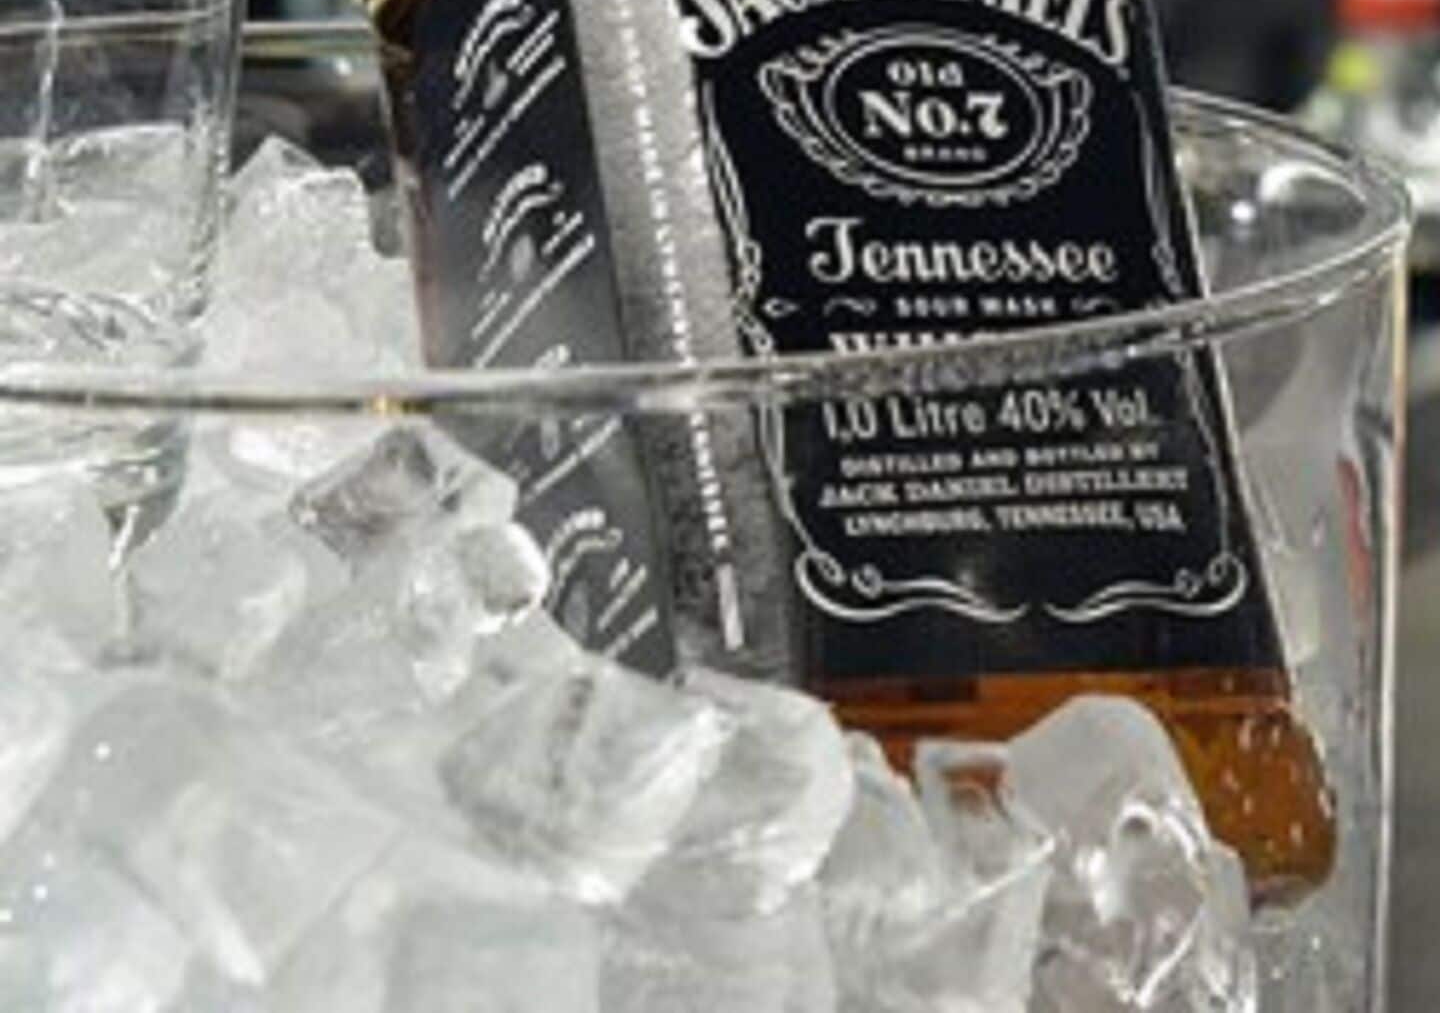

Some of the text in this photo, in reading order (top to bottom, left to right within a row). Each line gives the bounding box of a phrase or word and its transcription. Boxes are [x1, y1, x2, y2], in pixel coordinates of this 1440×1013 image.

[805, 217, 1118, 282] Tennessee
[888, 395, 986, 439] Litre
[998, 388, 1086, 432] 40%
